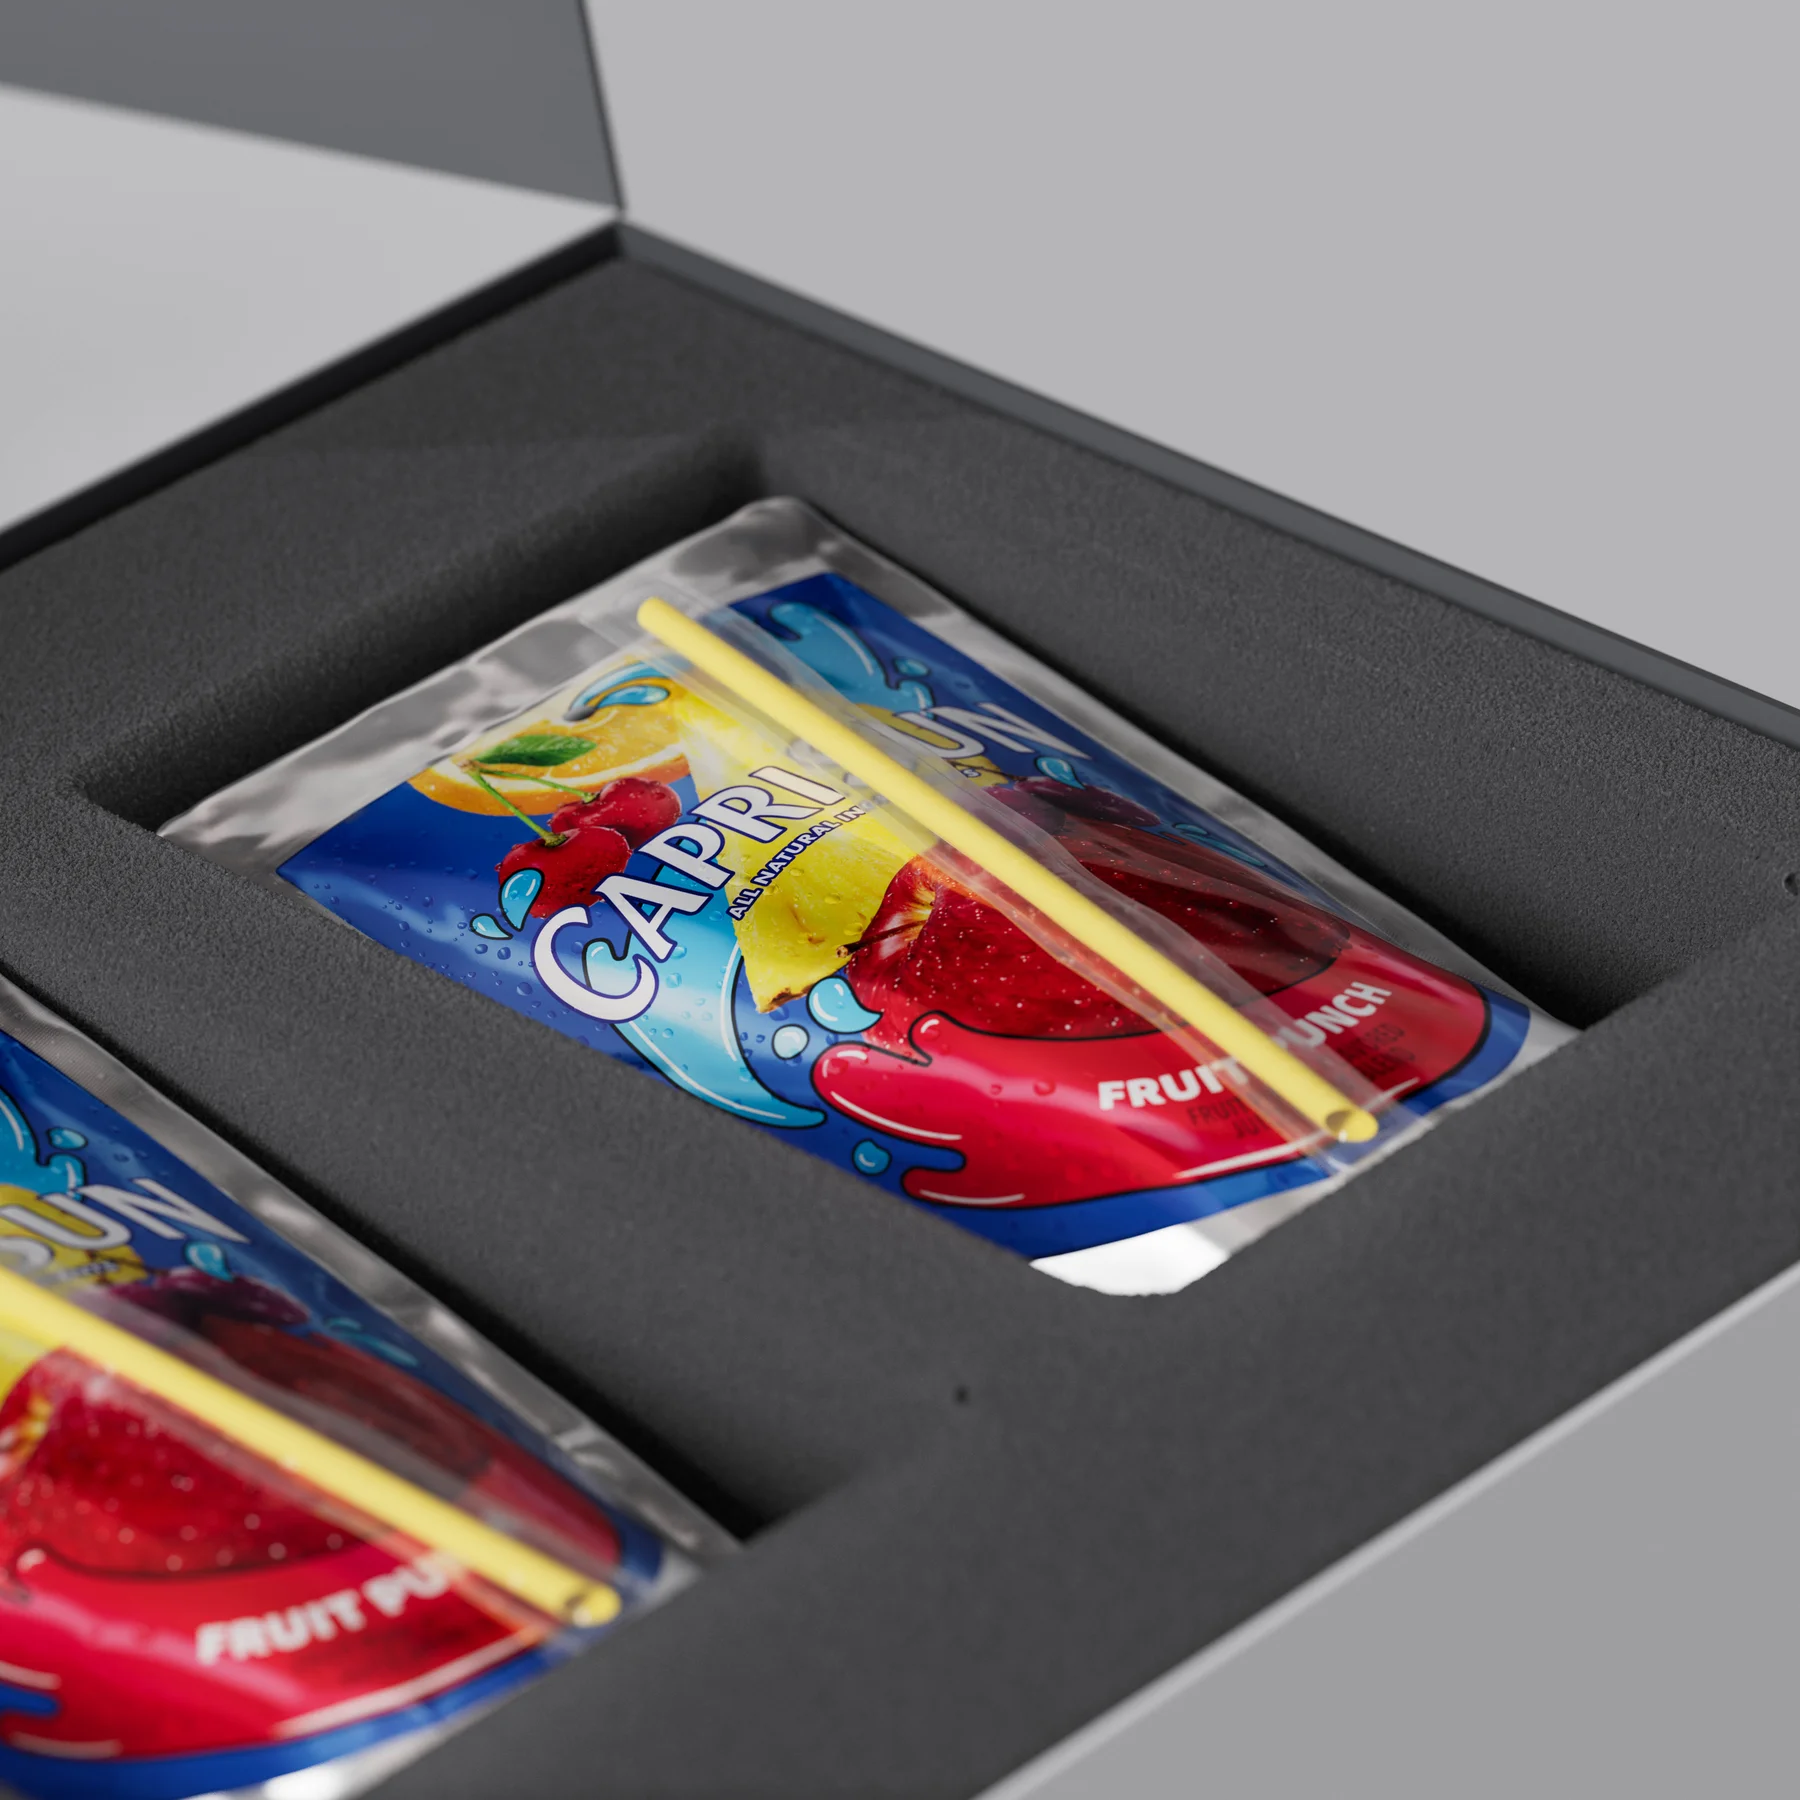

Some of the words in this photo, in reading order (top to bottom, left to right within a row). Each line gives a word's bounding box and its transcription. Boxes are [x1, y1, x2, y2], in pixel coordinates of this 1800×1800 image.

[530, 766, 845, 1023] CAPRI
[726, 884, 764, 921] ALL
[751, 819, 843, 887] NATURAL
[1097, 1057, 1249, 1111] FRUIT
[1272, 981, 1393, 1049] UNCH
[195, 1588, 367, 1666] FRUIT
